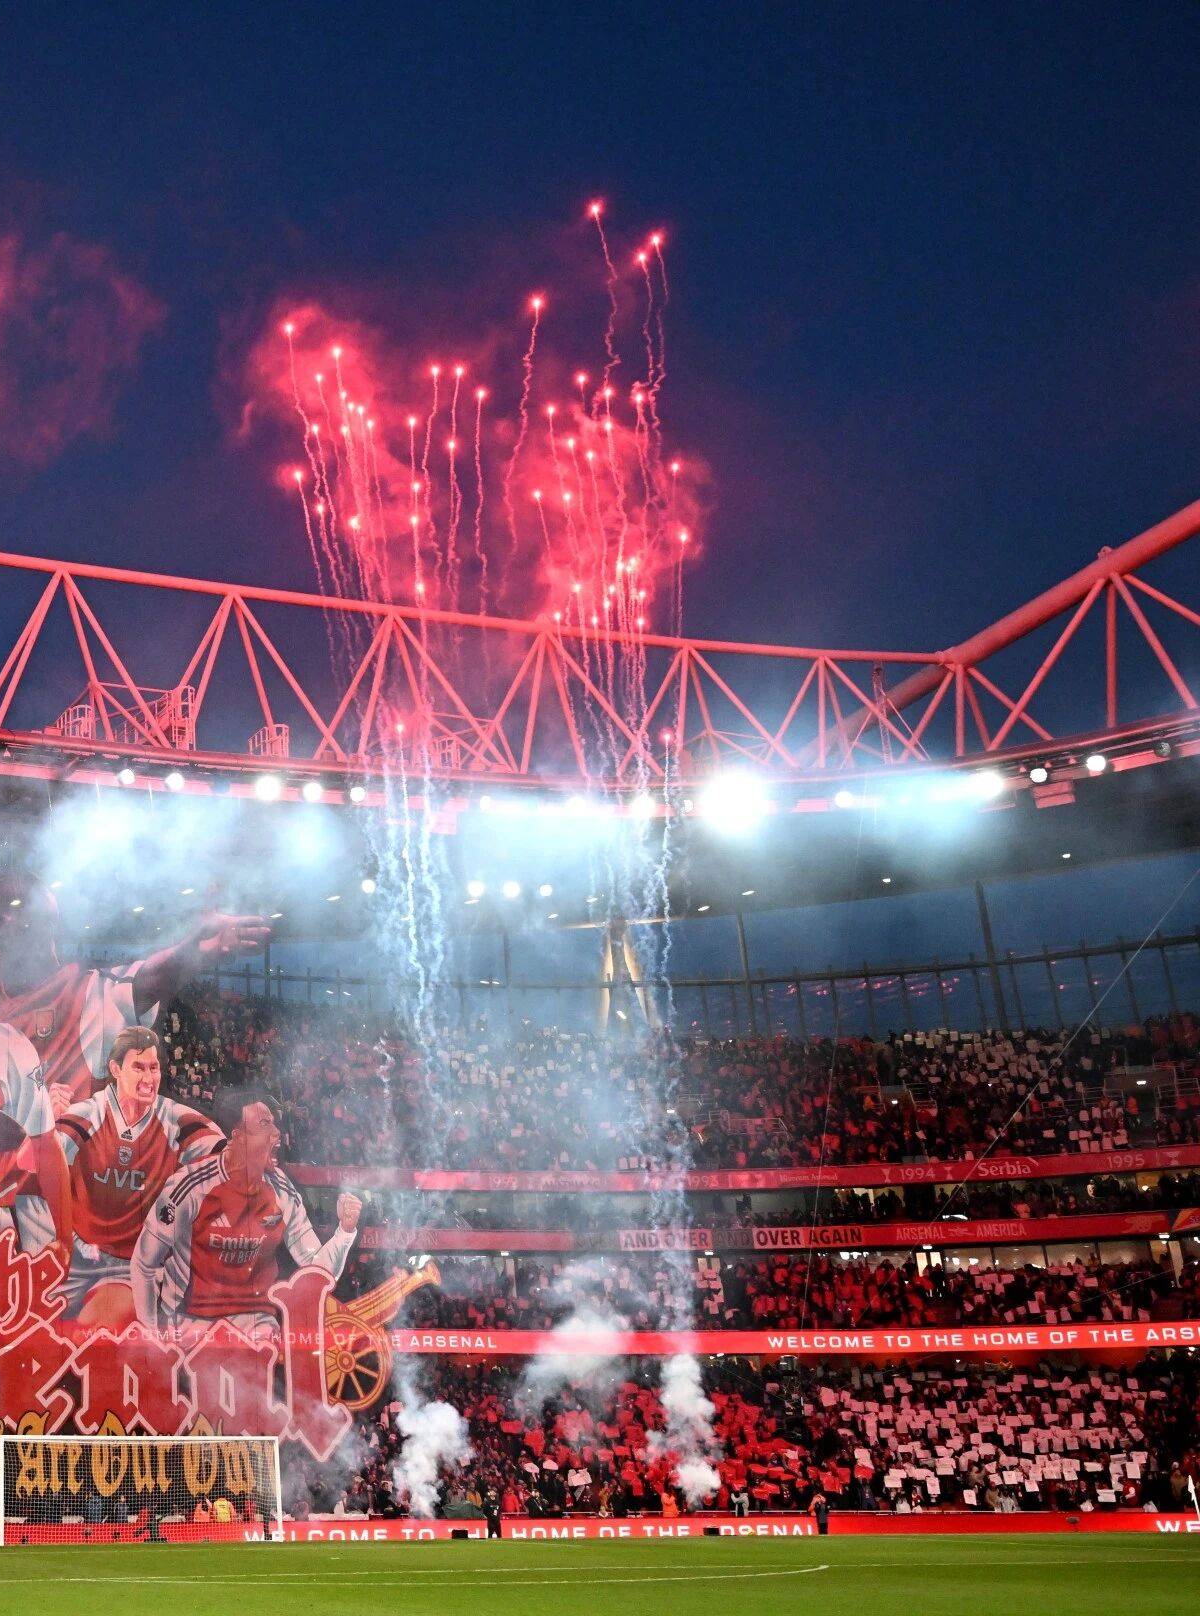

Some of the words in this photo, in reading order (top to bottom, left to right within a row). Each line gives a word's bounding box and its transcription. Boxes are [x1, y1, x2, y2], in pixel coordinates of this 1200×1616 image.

[977, 1161, 1032, 1177] Serbia
[1107, 1154, 1146, 1169] 1995
[93, 1168, 146, 1191] JVC
[900, 1167, 936, 1180] 1994
[624, 1232, 658, 1248] AND
[664, 1231, 709, 1248] OVER
[756, 1231, 801, 1246] OVER
[808, 1228, 863, 1246] AGAIN
[896, 1226, 946, 1241] ARSENAL
[976, 1222, 1027, 1238] AMERICA
[82, 1328, 183, 1342] WCOME
[410, 1335, 497, 1349] ARSENAL
[768, 1335, 875, 1348] WELCOME
[884, 1335, 911, 1347] TO
[921, 1333, 964, 1347] THE
[974, 1331, 1039, 1346] HOME
[1050, 1331, 1080, 1344] OF
[1089, 1329, 1134, 1343] THE
[1146, 1326, 1200, 1341] ARS
[719, 1524, 814, 1536] RSENAL
